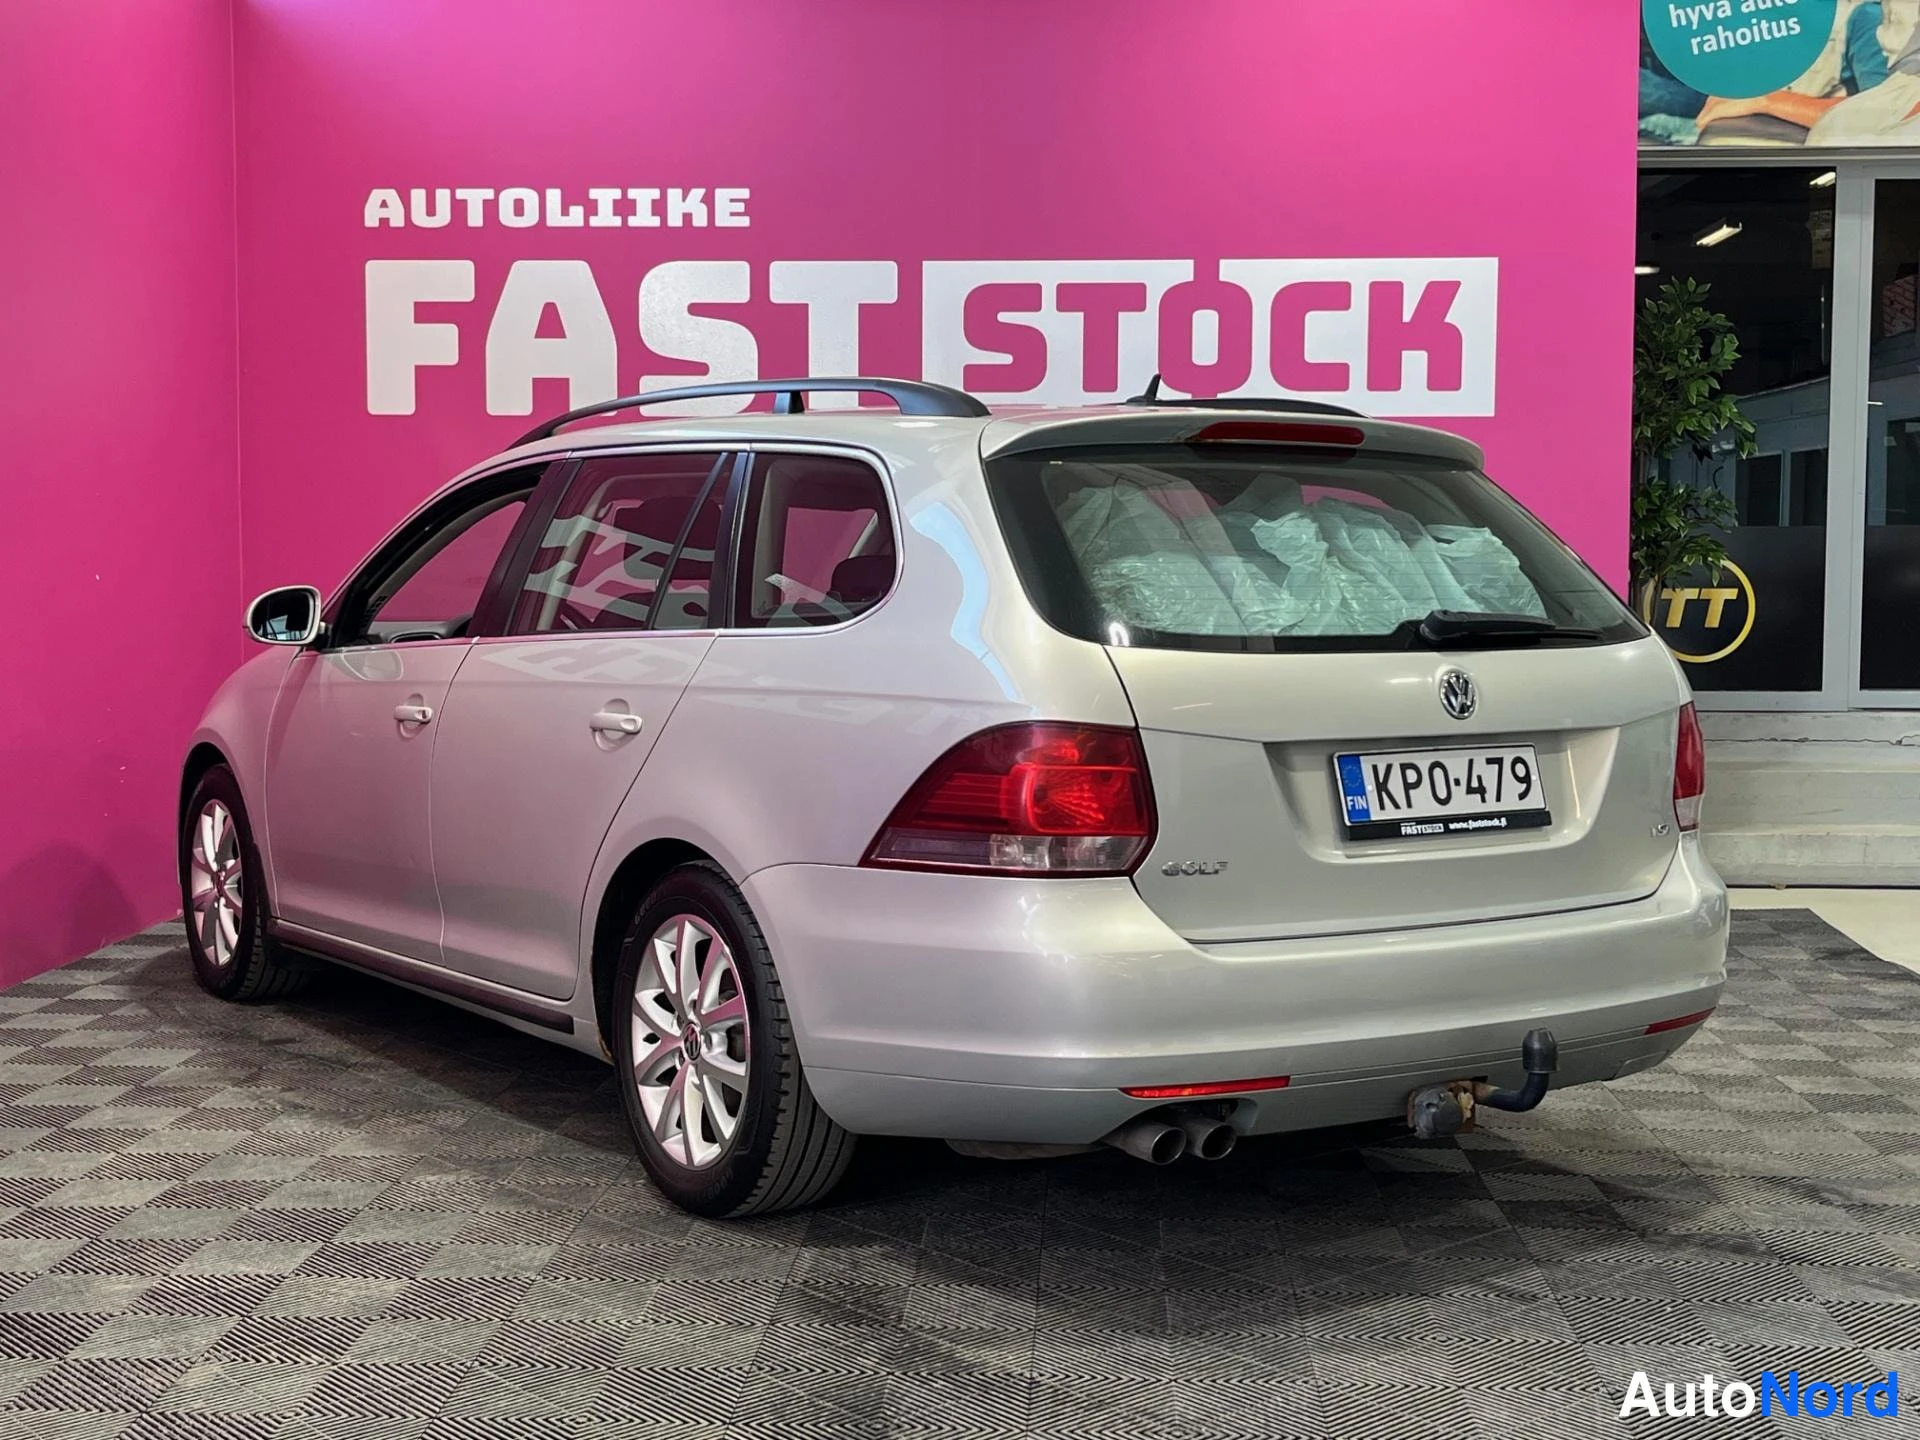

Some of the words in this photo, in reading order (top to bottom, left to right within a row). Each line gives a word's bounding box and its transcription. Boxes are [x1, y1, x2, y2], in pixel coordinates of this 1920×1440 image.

[1690, 17, 1801, 55] rahoitus
[364, 188, 751, 228] AUTOLIIKE
[1661, 587, 1739, 628] TT
[1346, 795, 1368, 810] FIN
[1161, 860, 1229, 876] GOLF
